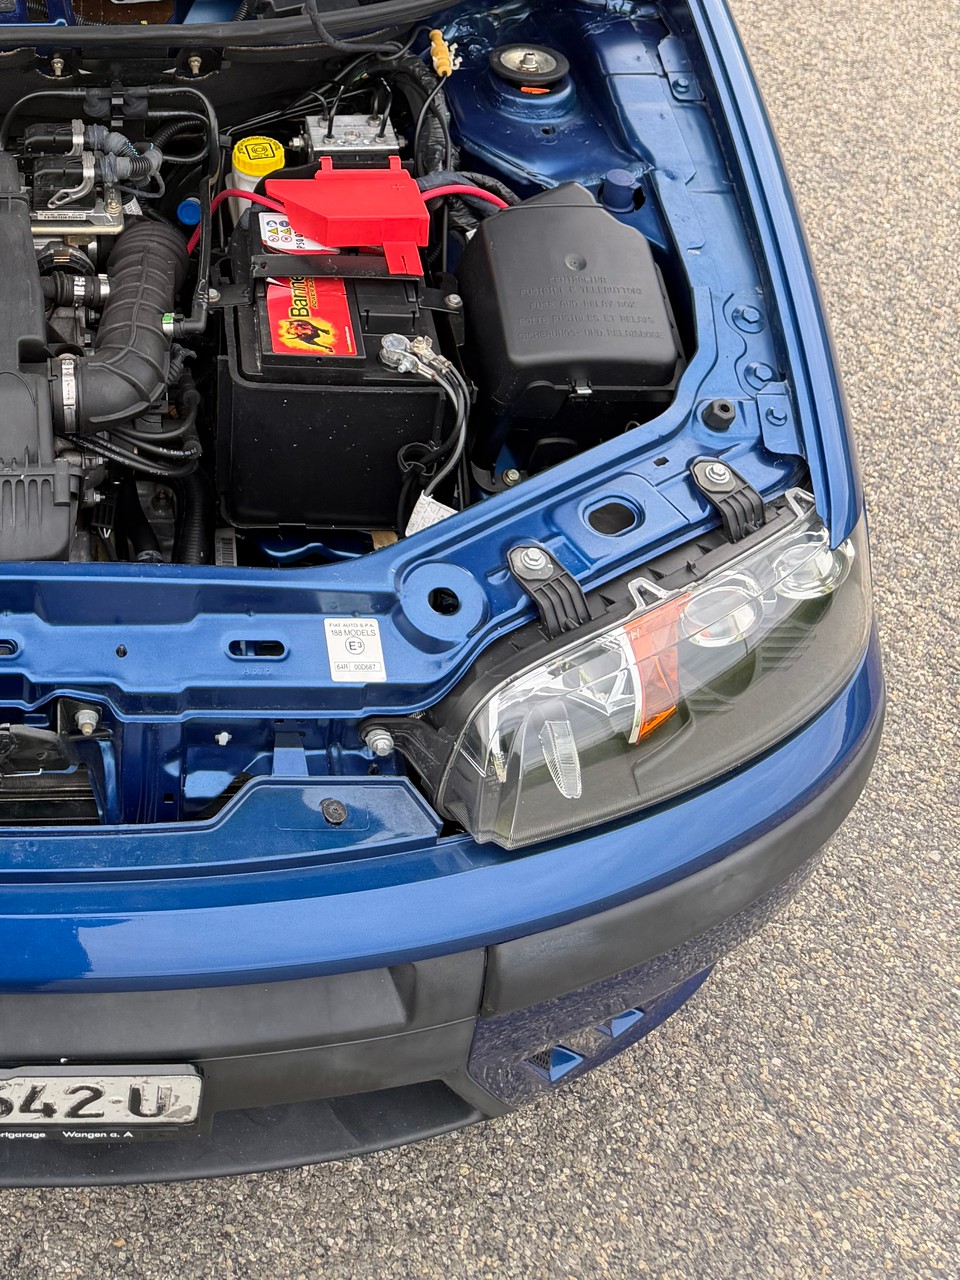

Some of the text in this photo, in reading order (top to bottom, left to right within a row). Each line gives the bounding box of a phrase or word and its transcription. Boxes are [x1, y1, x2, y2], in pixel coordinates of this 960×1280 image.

[290, 276, 310, 318] Banne
[344, 629, 376, 637] MODELS
[128, 1081, 173, 1118] U
[62, 1131, 107, 1140] Wangen
